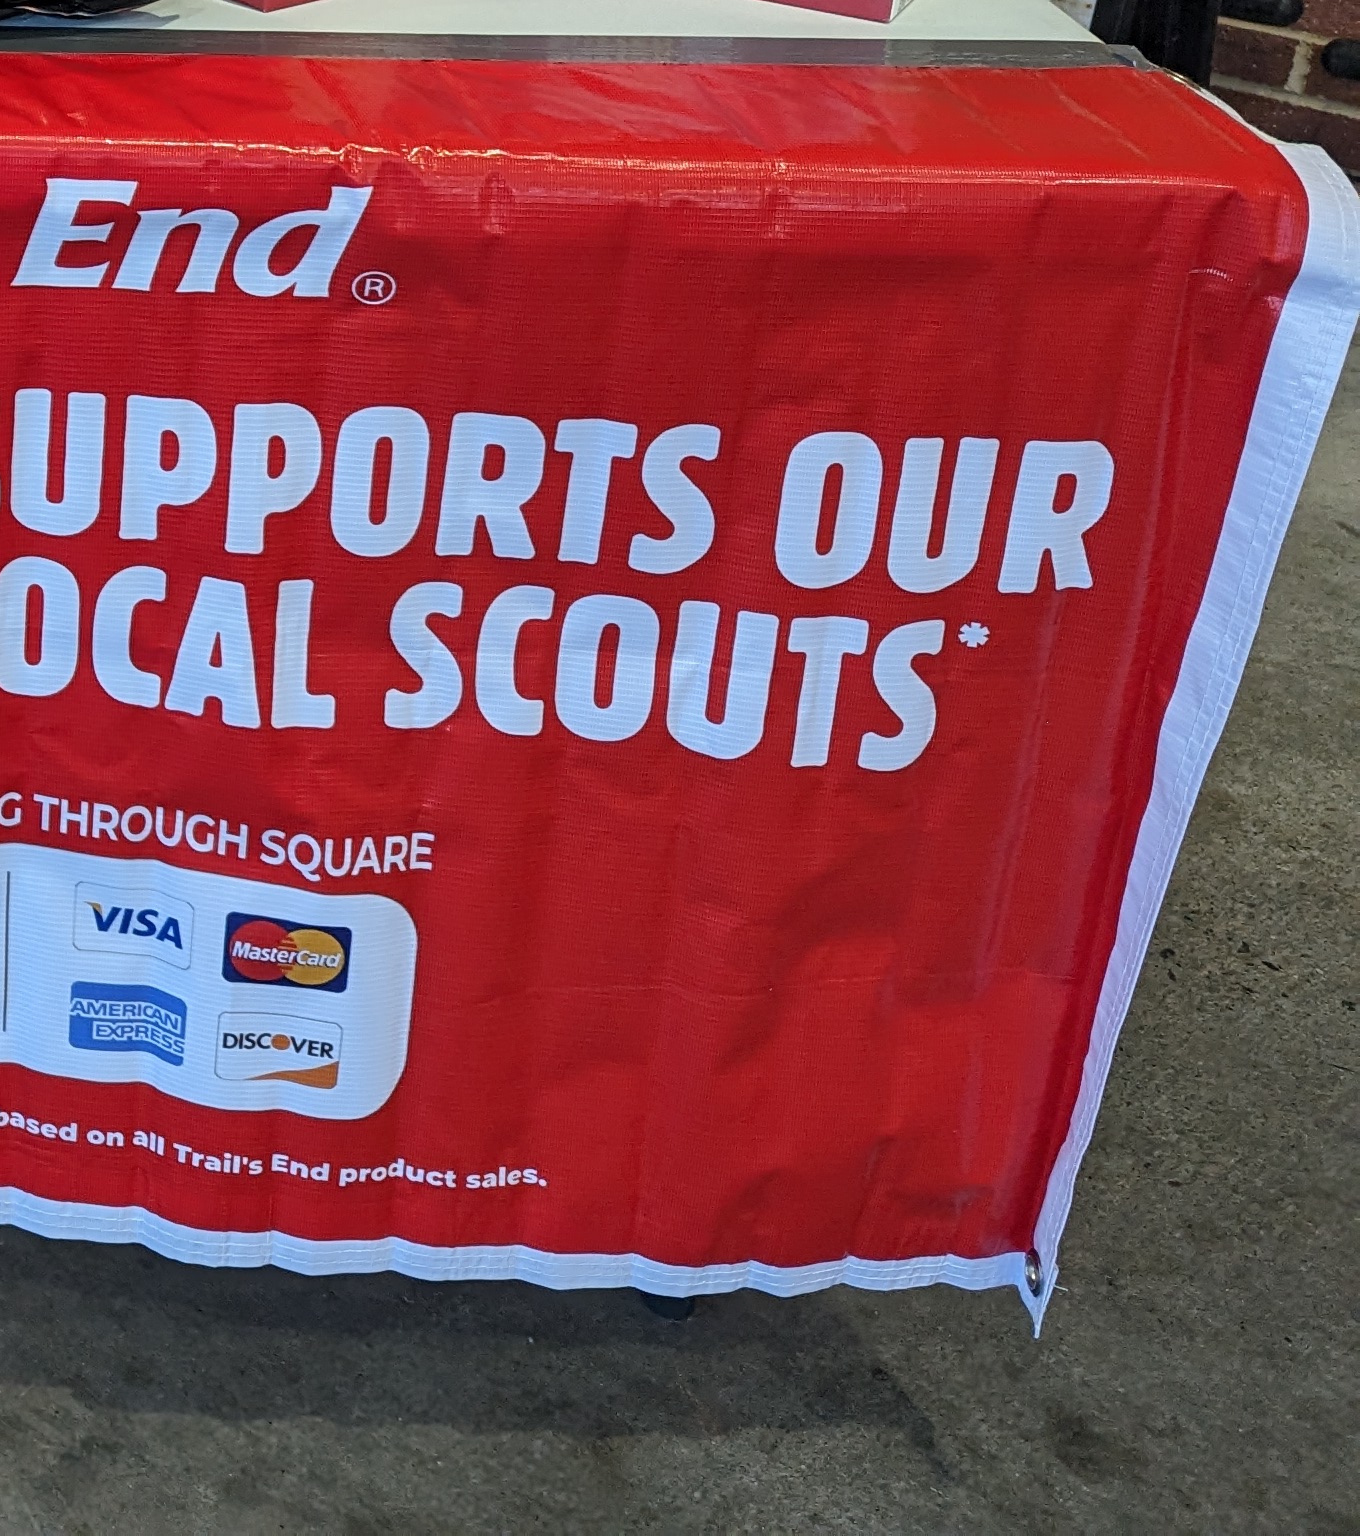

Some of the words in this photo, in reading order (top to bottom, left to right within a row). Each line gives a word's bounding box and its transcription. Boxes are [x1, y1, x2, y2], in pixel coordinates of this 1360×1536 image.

[11, 177, 375, 300] End
[773, 429, 1116, 595] OUR
[33, 794, 249, 860] THROUGH
[259, 831, 435, 882] SQUARE
[86, 902, 184, 951] VISA
[231, 938, 342, 969] MasterCard
[69, 998, 181, 1032] AMERICAN
[92, 1020, 186, 1055] EXPRESS
[85, 1127, 124, 1147] on
[132, 1129, 165, 1156] all
[172, 1143, 264, 1175] Trail's
[270, 1154, 330, 1183] End
[338, 1158, 457, 1188] product
[464, 1165, 548, 1189] sales.
